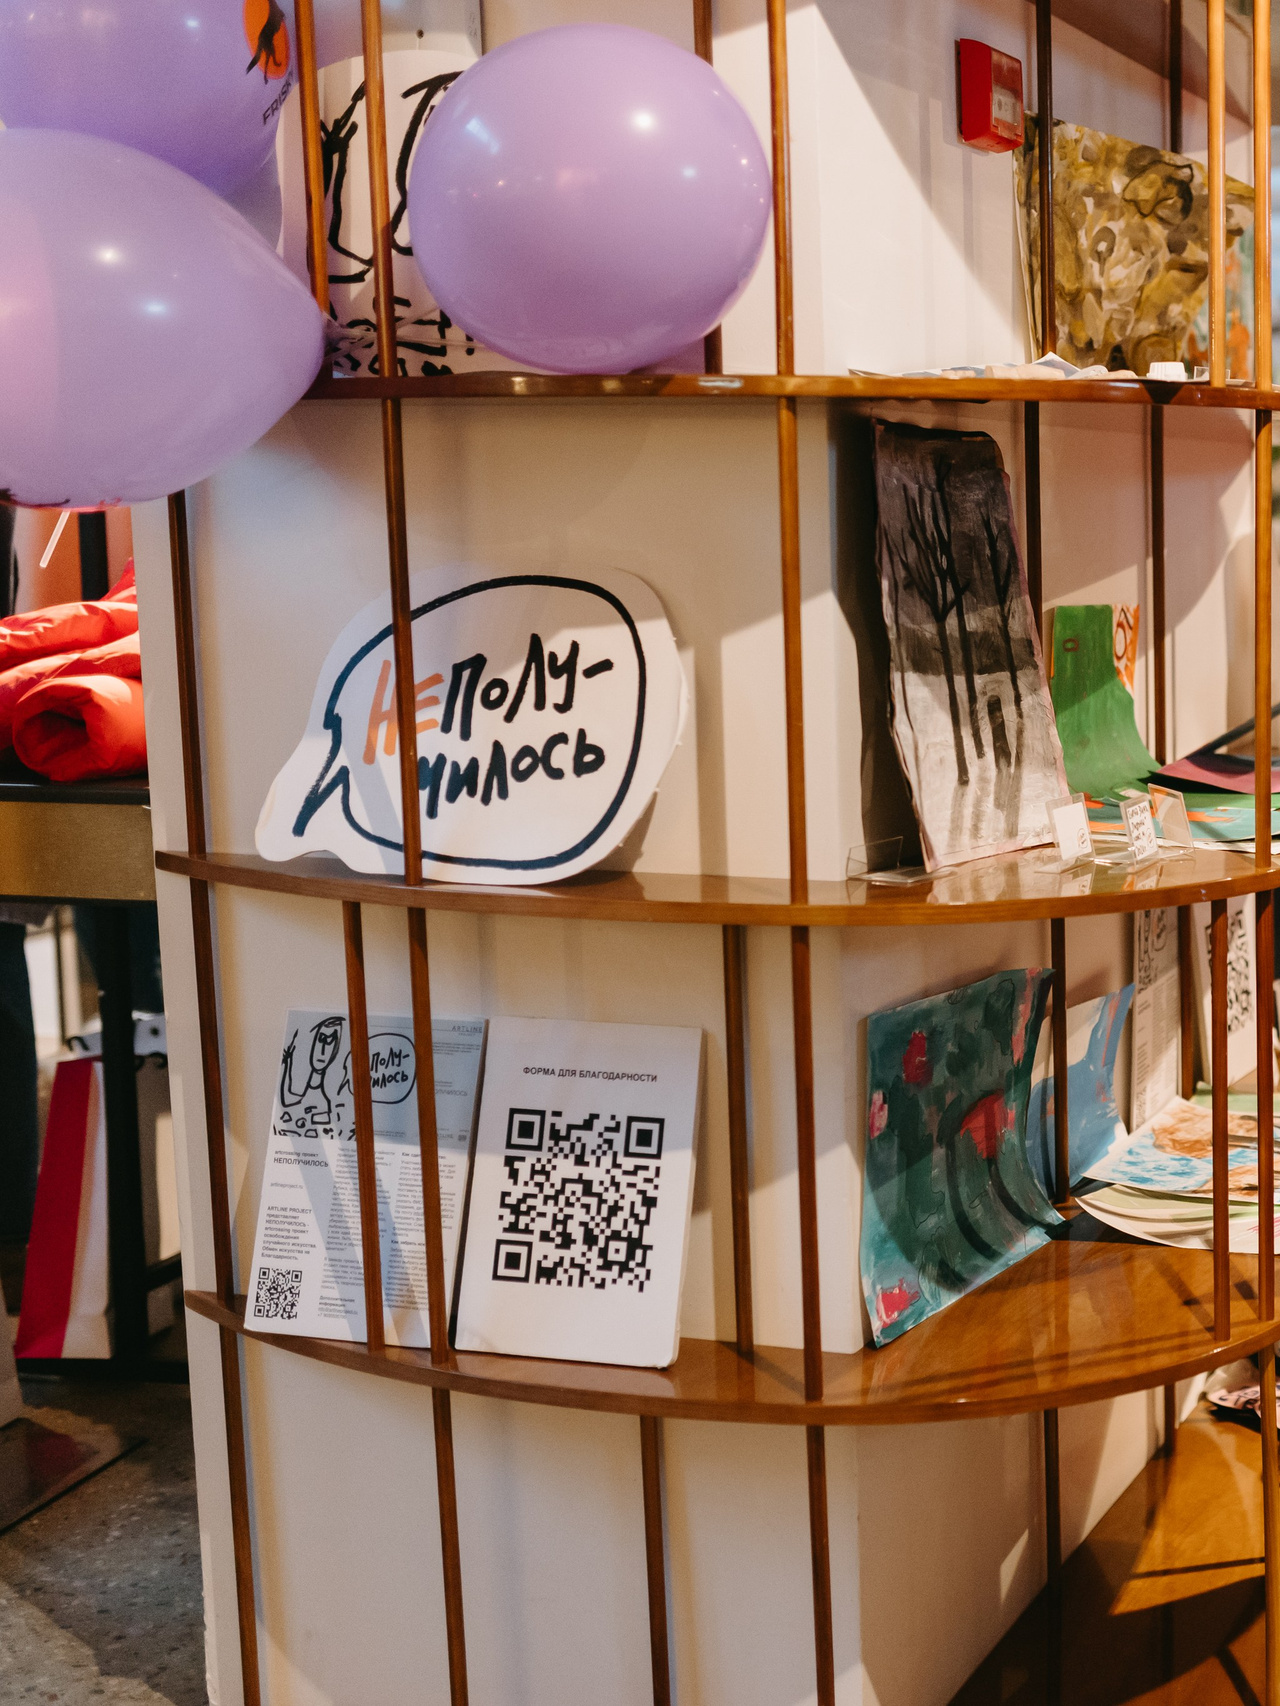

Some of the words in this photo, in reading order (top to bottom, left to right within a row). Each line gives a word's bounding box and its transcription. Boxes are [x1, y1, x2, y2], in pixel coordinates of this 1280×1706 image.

[370, 1046, 410, 1073] ПОЛУ-
[370, 1070, 409, 1089] ИЛОСЬ
[522, 1066, 556, 1077] ФОРМА
[557, 1068, 577, 1078] ДЛЯ
[579, 1069, 658, 1083] БЛАГОДАРНОСТИ
[273, 1157, 329, 1168] НЕПОЛУЧИЛОСЬ
[267, 1205, 288, 1213] ARTLINE
